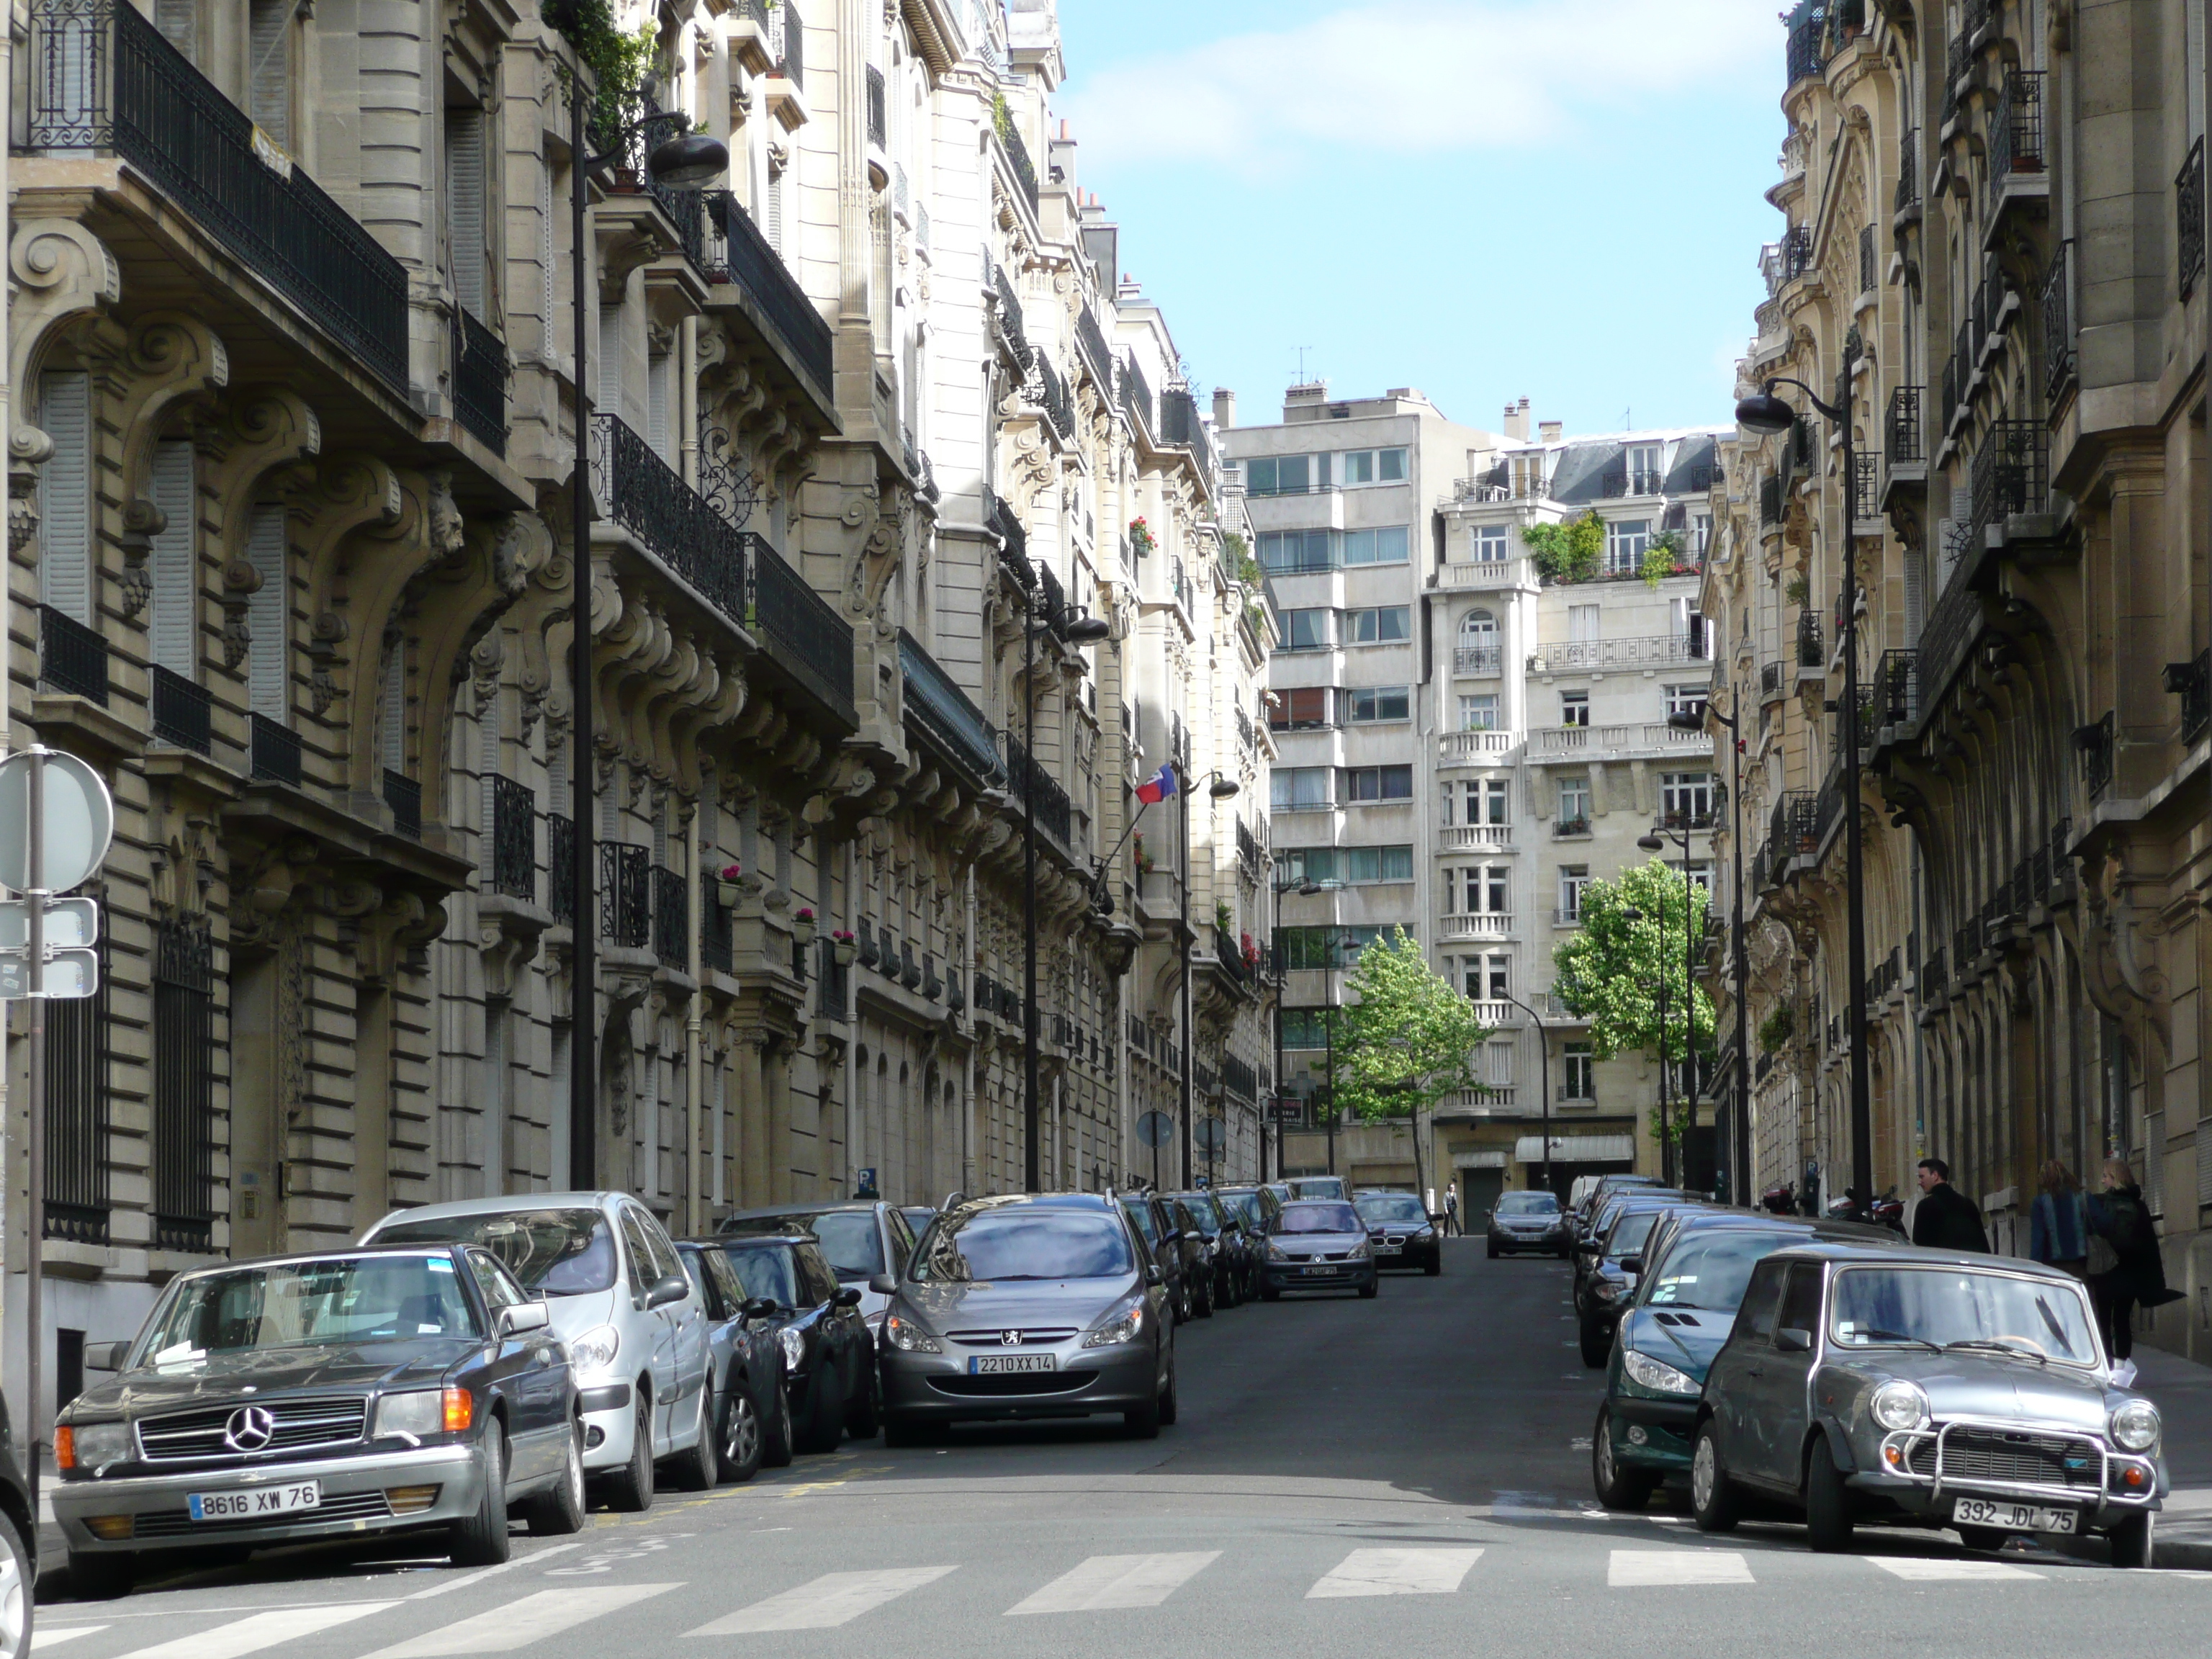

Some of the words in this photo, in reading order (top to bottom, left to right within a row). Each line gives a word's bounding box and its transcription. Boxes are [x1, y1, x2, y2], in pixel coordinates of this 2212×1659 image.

[859, 1170, 871, 1184] P
[980, 1357, 1014, 1372] 2210
[1016, 1357, 1033, 1371] XX
[1035, 1356, 1051, 1370] 14
[203, 1496, 249, 1515] 8616
[256, 1491, 282, 1511] XW
[288, 1485, 315, 1507] 76
[1959, 1501, 1997, 1524] 392
[2004, 1506, 2040, 1529] JDL
[2050, 1511, 2074, 1532] 75
